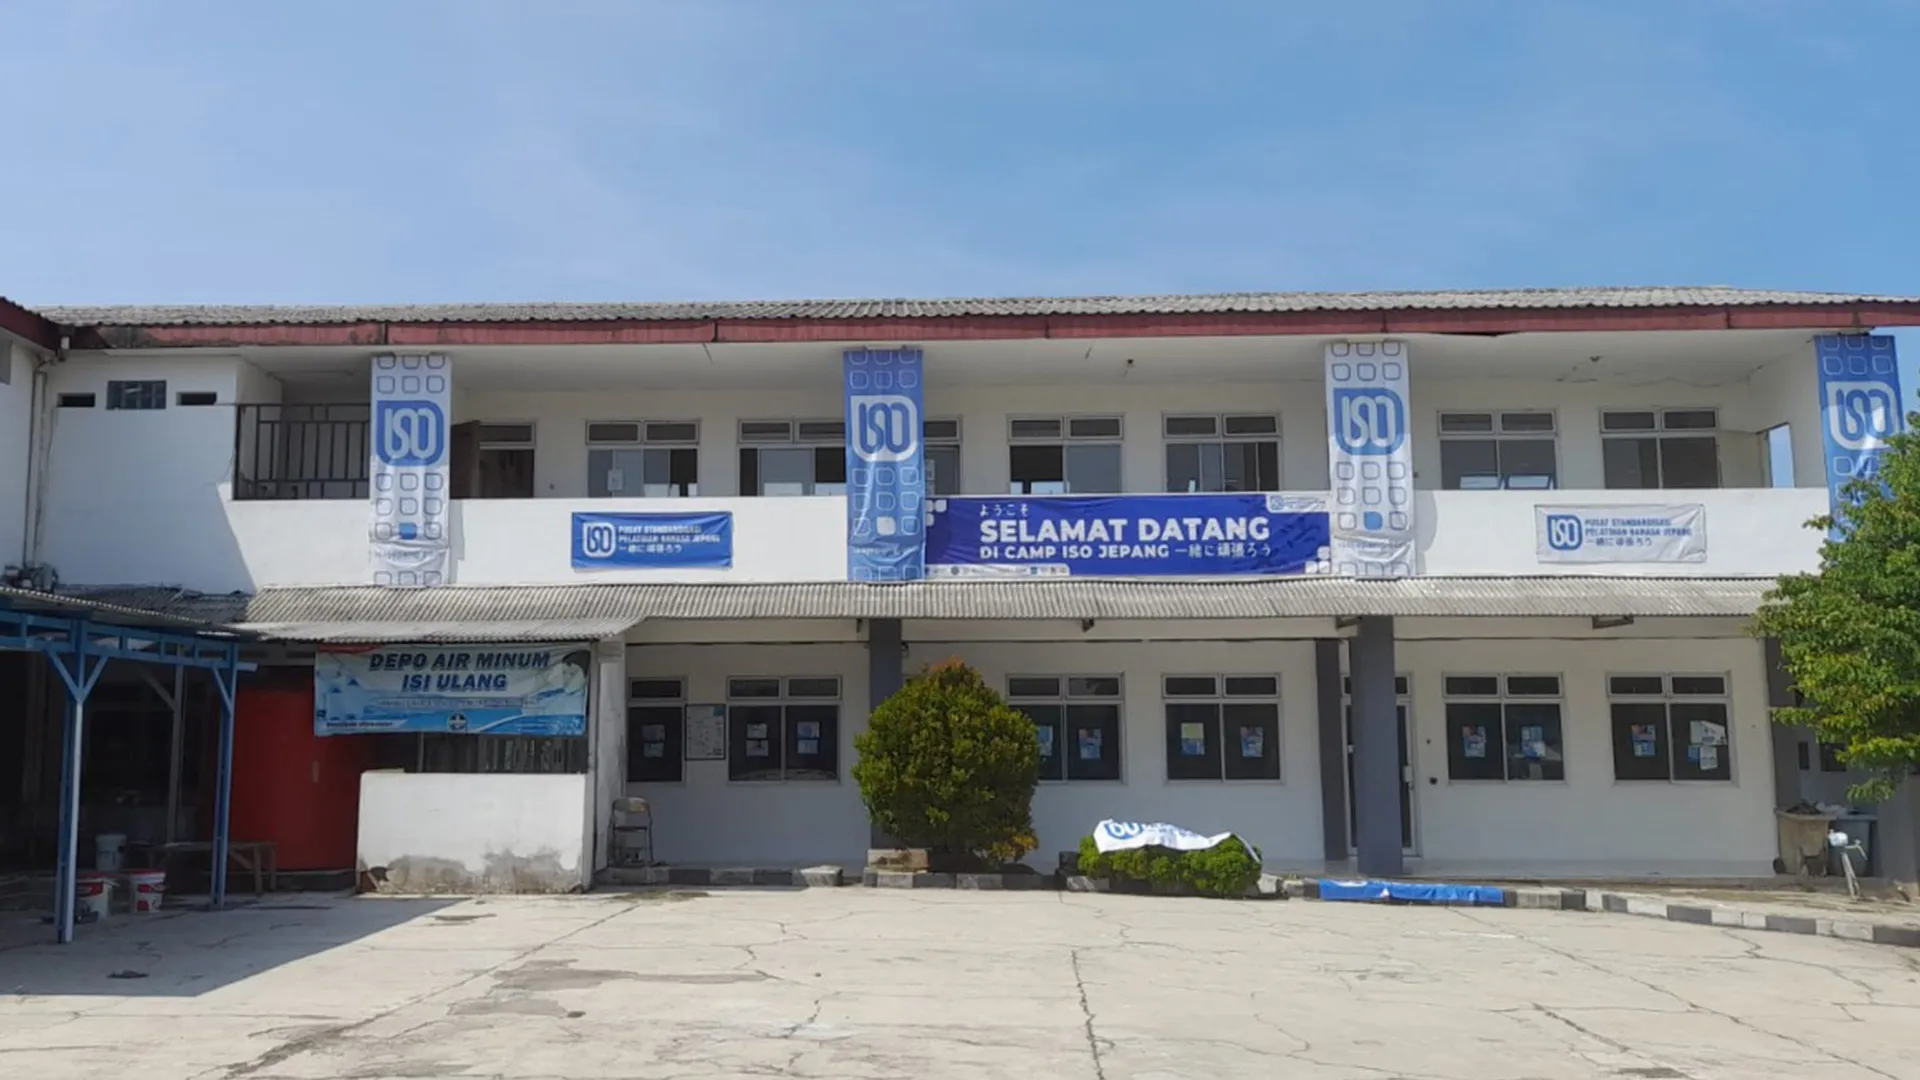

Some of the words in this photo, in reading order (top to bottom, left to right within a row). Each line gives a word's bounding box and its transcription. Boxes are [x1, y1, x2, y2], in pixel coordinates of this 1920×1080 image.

[980, 503, 1028, 517] ようこそ
[980, 518, 1128, 543] SELAMAT
[1137, 516, 1270, 541] DATANG
[1585, 518, 1609, 526] PUSAT
[979, 545, 998, 559] DI
[1004, 545, 1056, 559] CAMP
[1062, 545, 1093, 559] ISO
[1098, 544, 1170, 559] JEPANG
[1174, 541, 1272, 559] 一緒に頑張ろう
[369, 653, 427, 670] DEPO
[431, 652, 470, 670] AIR
[475, 652, 550, 670] MINUM
[402, 674, 430, 691] ISI
[436, 674, 508, 691] ULANG
